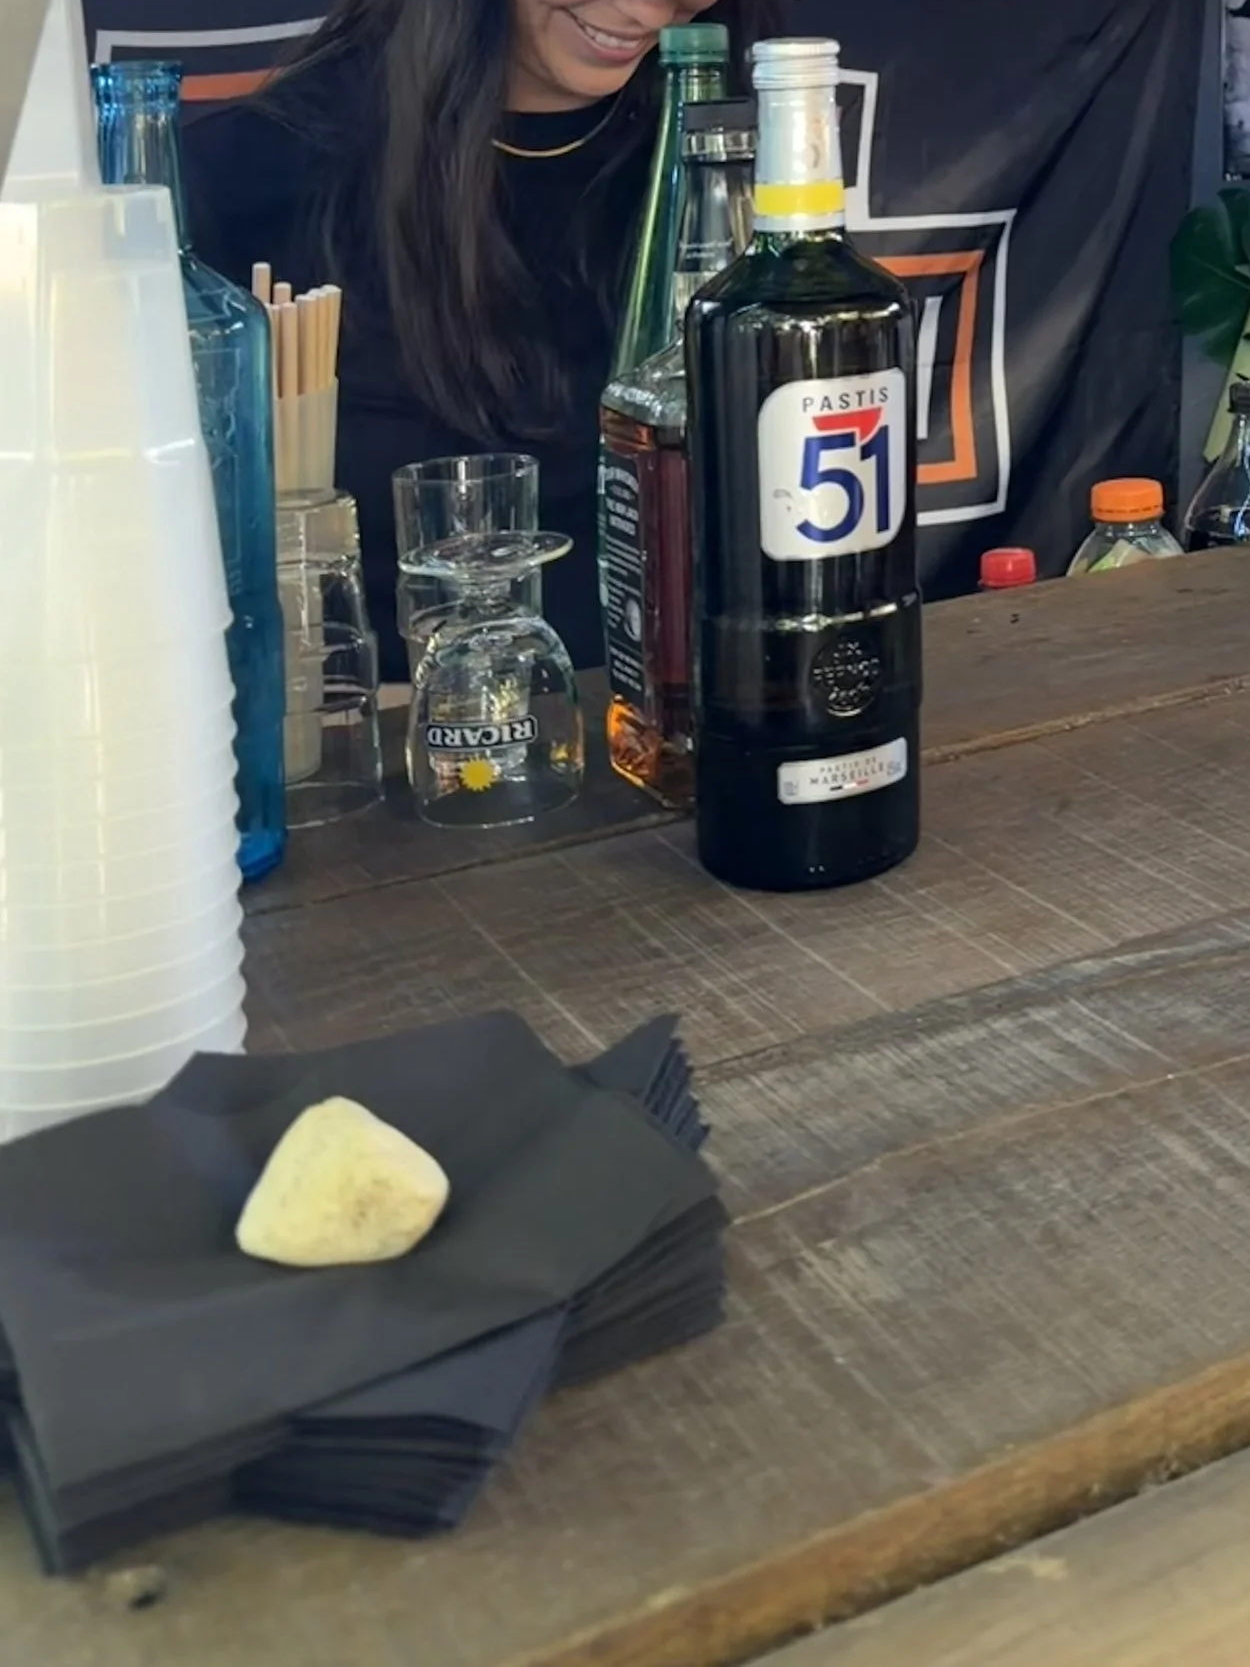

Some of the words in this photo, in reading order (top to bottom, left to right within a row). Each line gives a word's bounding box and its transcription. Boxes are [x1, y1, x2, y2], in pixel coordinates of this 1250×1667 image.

[802, 387, 889, 413] PASTIS
[796, 425, 890, 543] 51
[427, 721, 534, 747] RICARD
